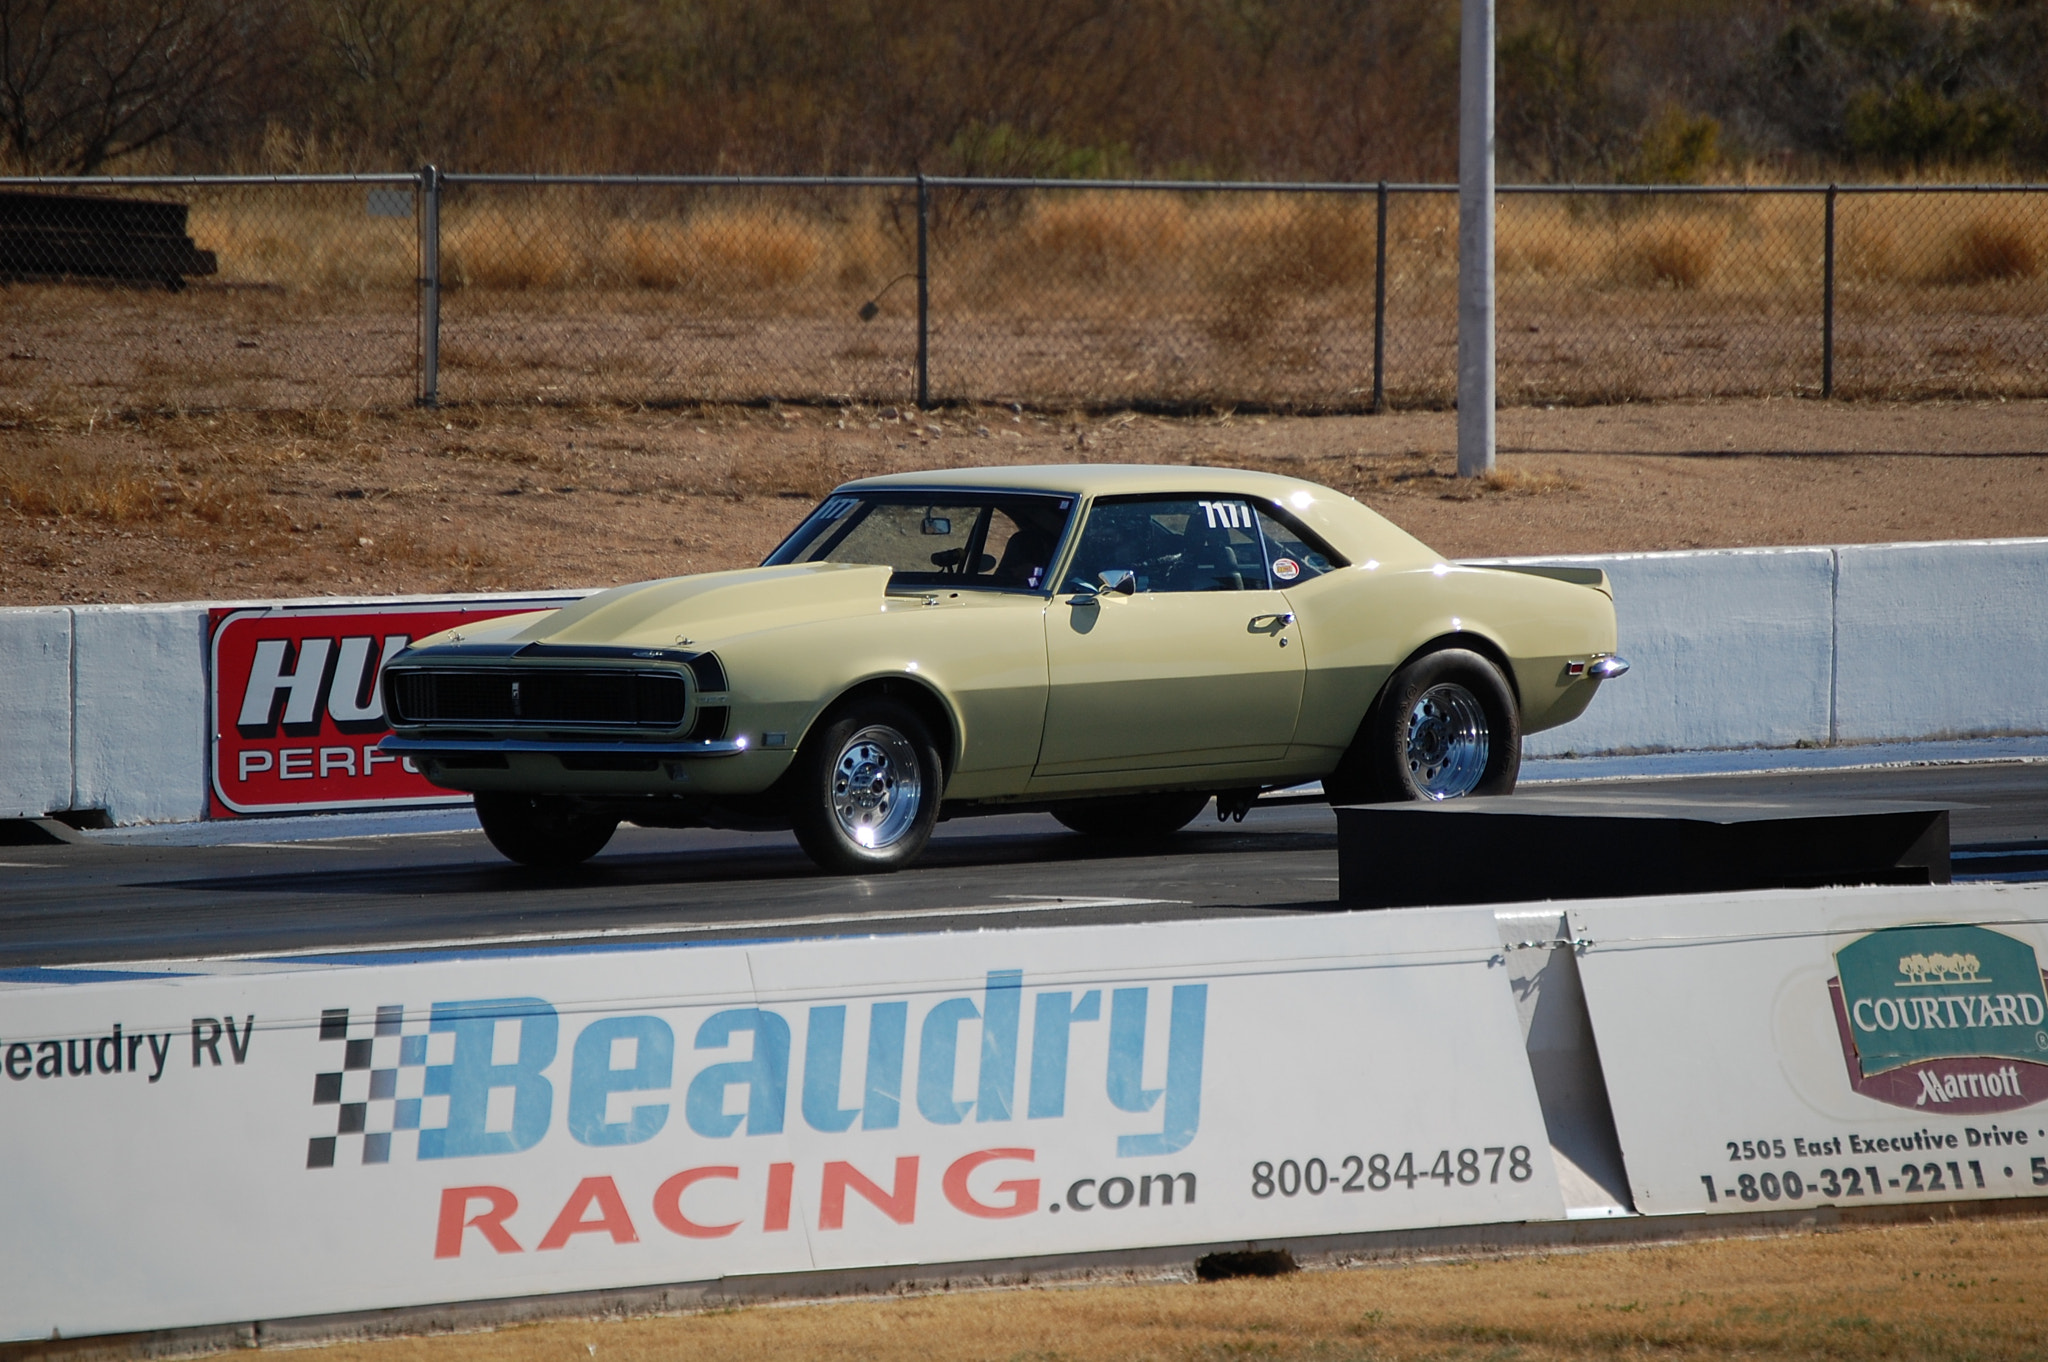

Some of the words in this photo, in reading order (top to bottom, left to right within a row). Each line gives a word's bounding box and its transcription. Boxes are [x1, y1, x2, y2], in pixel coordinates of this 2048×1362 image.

[1852, 993, 2045, 1033] COURTYARD
[0, 1023, 171, 1084] eaudry
[191, 1014, 255, 1068] RV
[416, 968, 1209, 1161] Beaudry
[1917, 1066, 2022, 1106] Marriott
[1726, 1138, 1787, 1161] 2505
[1794, 1135, 1842, 1158] East
[1849, 1127, 1959, 1155] Executive
[1964, 1124, 2029, 1148] Drive
[1250, 1145, 1534, 1200] 800-284-4878
[1700, 1159, 1986, 1203] 1-800-321-2211
[433, 1147, 1198, 1260] RACING.com
